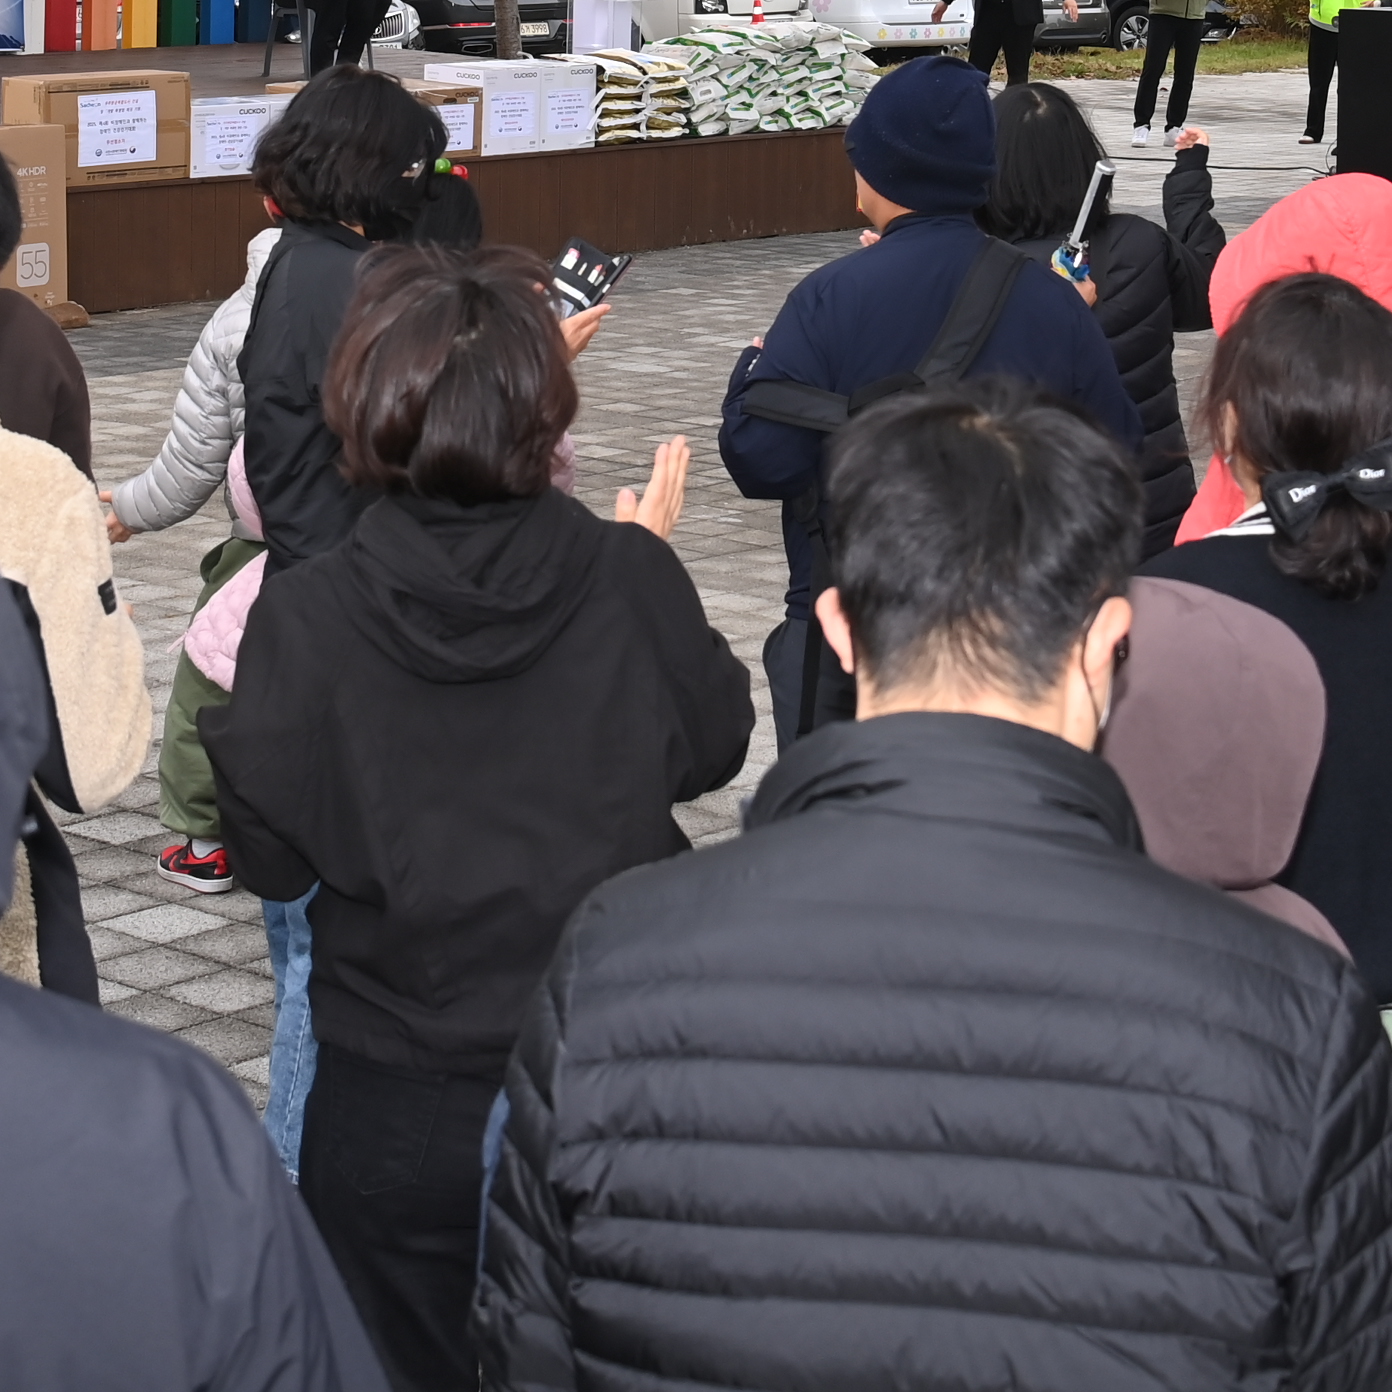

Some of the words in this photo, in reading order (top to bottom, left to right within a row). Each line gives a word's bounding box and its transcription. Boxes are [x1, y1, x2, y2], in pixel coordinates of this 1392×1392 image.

[456, 72, 480, 80] CUCKOO
[514, 71, 538, 79] CUCKOO
[28, 166, 46, 176] HDR
[20, 249, 47, 280] 55
[1359, 468, 1386, 479] Dior
[1288, 484, 1317, 503] Dior
